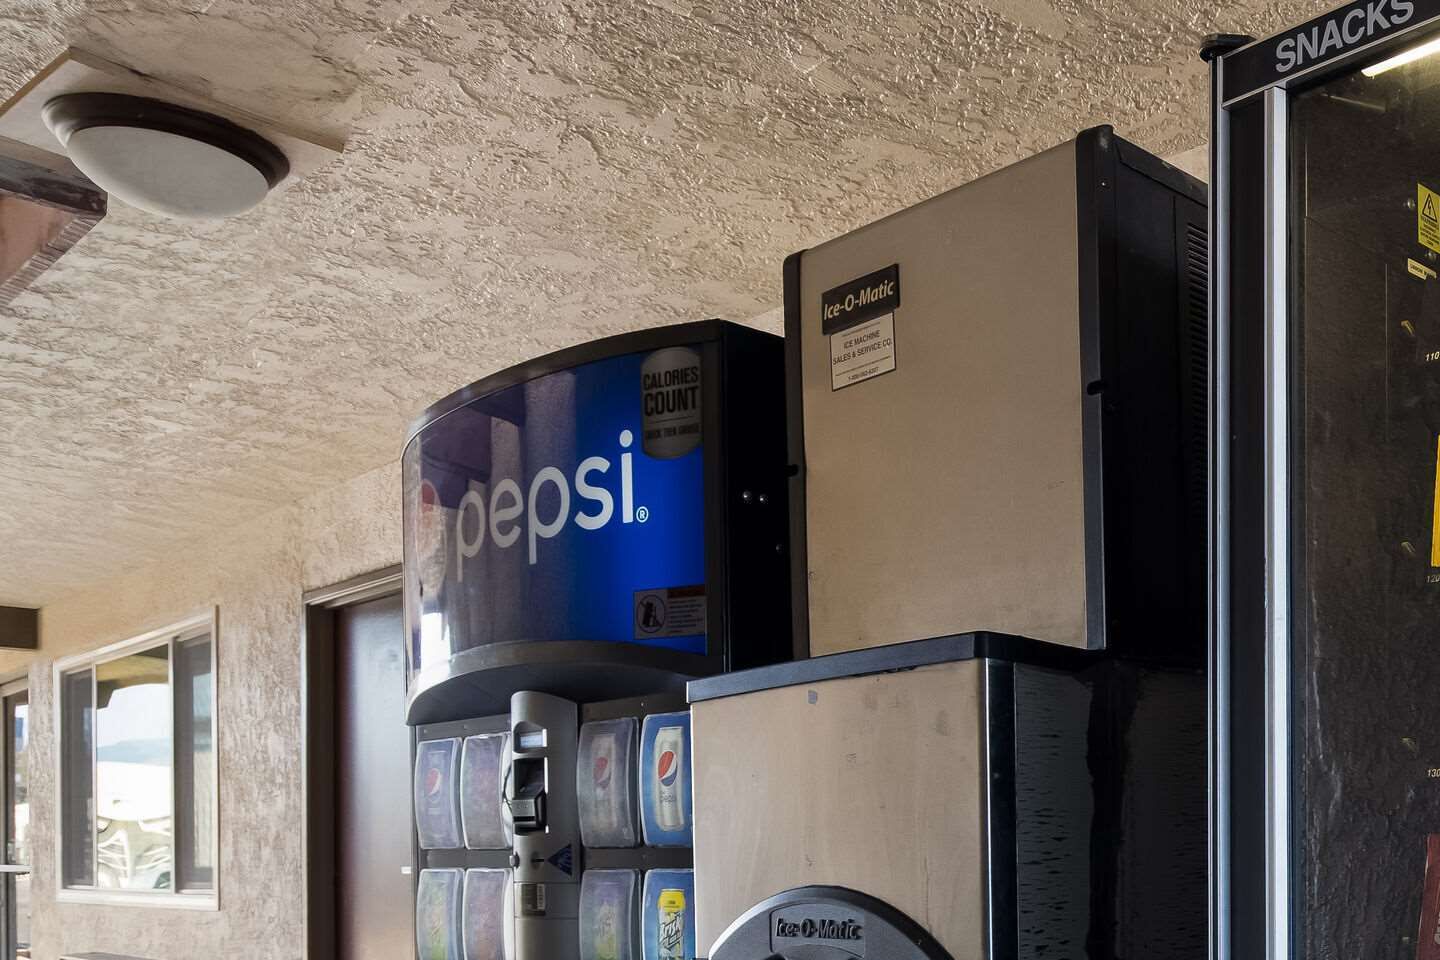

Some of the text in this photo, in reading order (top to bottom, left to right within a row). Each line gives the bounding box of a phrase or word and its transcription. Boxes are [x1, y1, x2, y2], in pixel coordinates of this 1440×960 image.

[1275, 0, 1414, 73] SNACKS
[824, 280, 895, 320] Ice-O-Matic
[843, 330, 881, 349] ICE MACHINE
[833, 353, 852, 365] SALES
[857, 342, 881, 356] SERVICE
[1425, 351, 1440, 362] 110
[643, 367, 698, 391] CALORIES
[644, 387, 699, 416] COUNT
[456, 429, 634, 583] pepsi
[1427, 768, 1440, 778] 130
[775, 918, 863, 940] Ice-O-Matic
